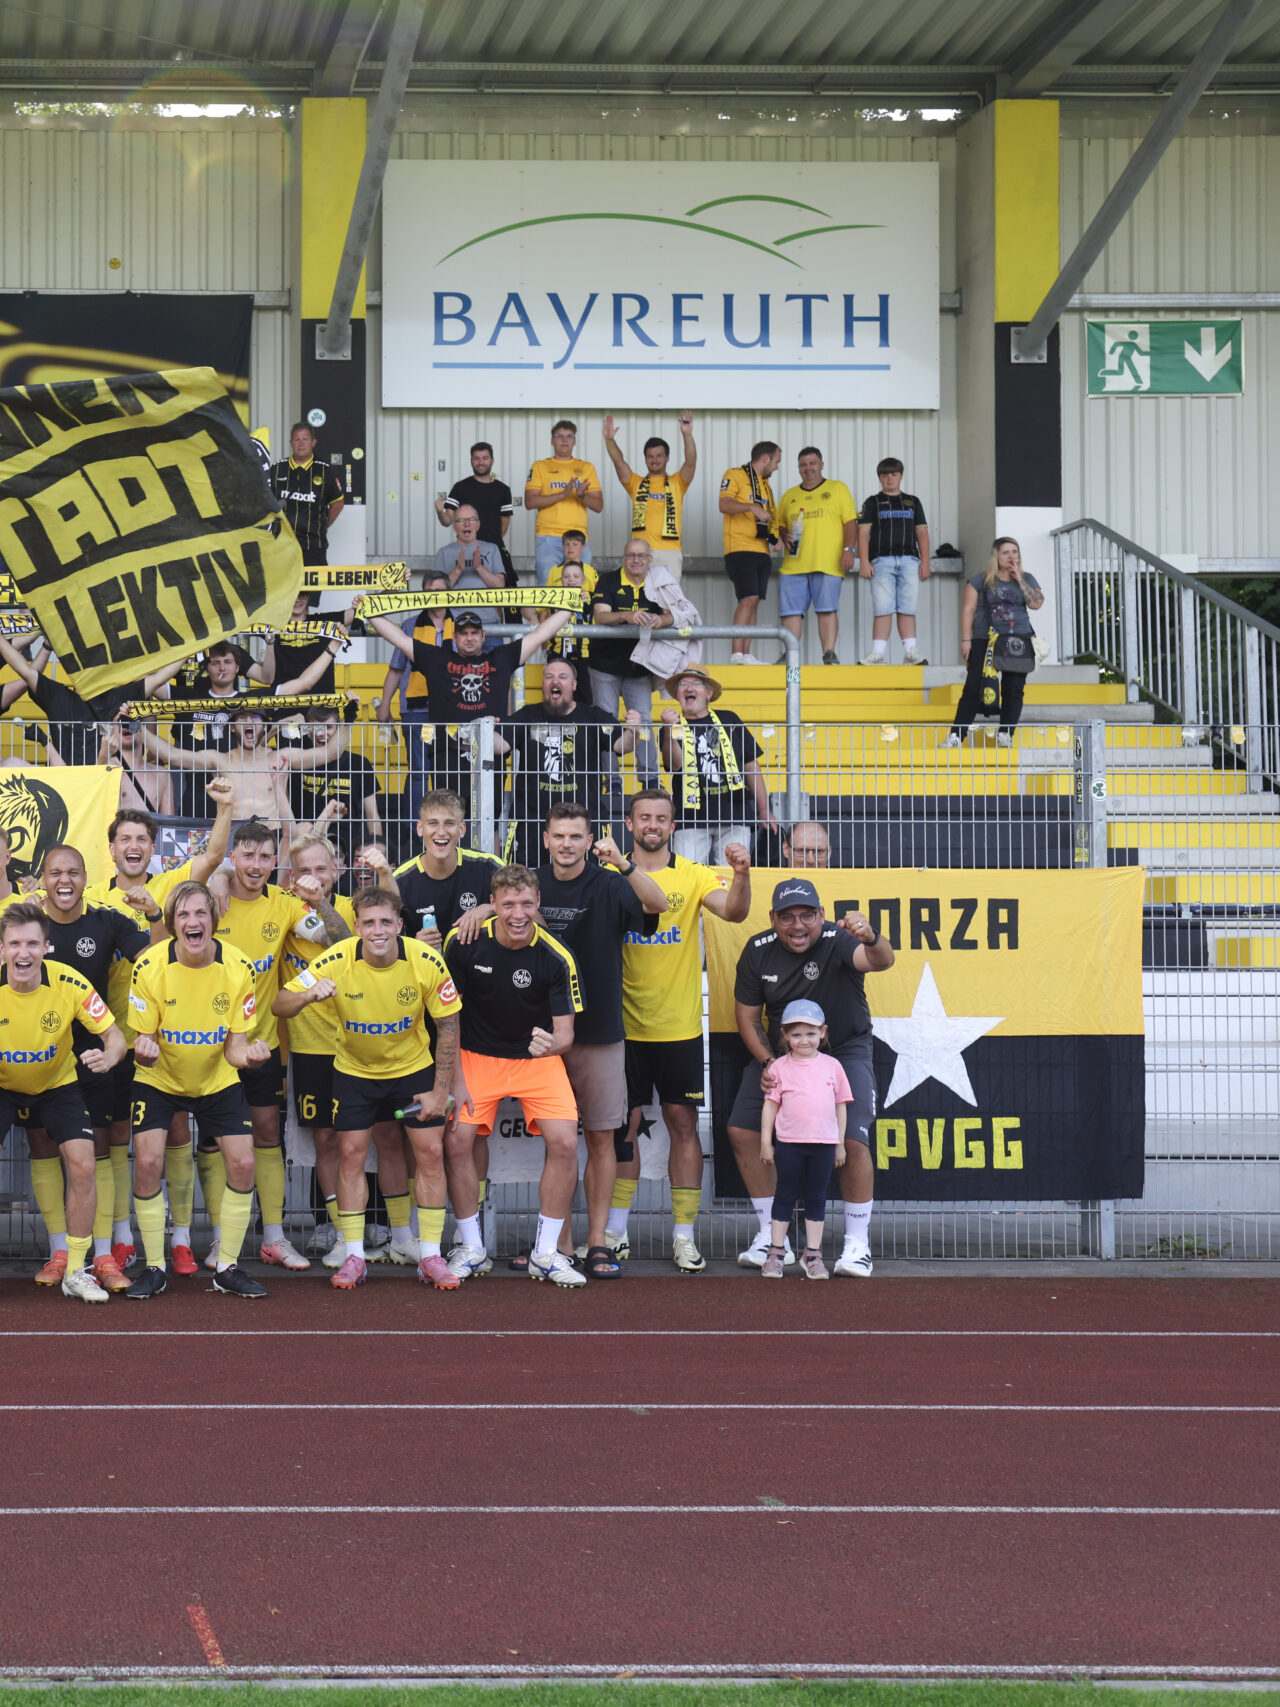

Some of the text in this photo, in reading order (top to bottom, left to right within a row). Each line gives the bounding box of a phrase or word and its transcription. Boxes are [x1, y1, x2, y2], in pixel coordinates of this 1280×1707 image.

[432, 291, 892, 369] BAYREUTH
[281, 490, 316, 502] maxit
[328, 570, 377, 586] LEBEN!
[53, 541, 267, 673] LEKTIV
[531, 590, 565, 605] 1921
[624, 926, 681, 945] maxit
[253, 954, 274, 973] xit
[345, 1016, 414, 1035] maxit
[160, 1026, 228, 1045] maxit
[298, 1094, 318, 1120] 16
[876, 1117, 1023, 1170] PVGG
